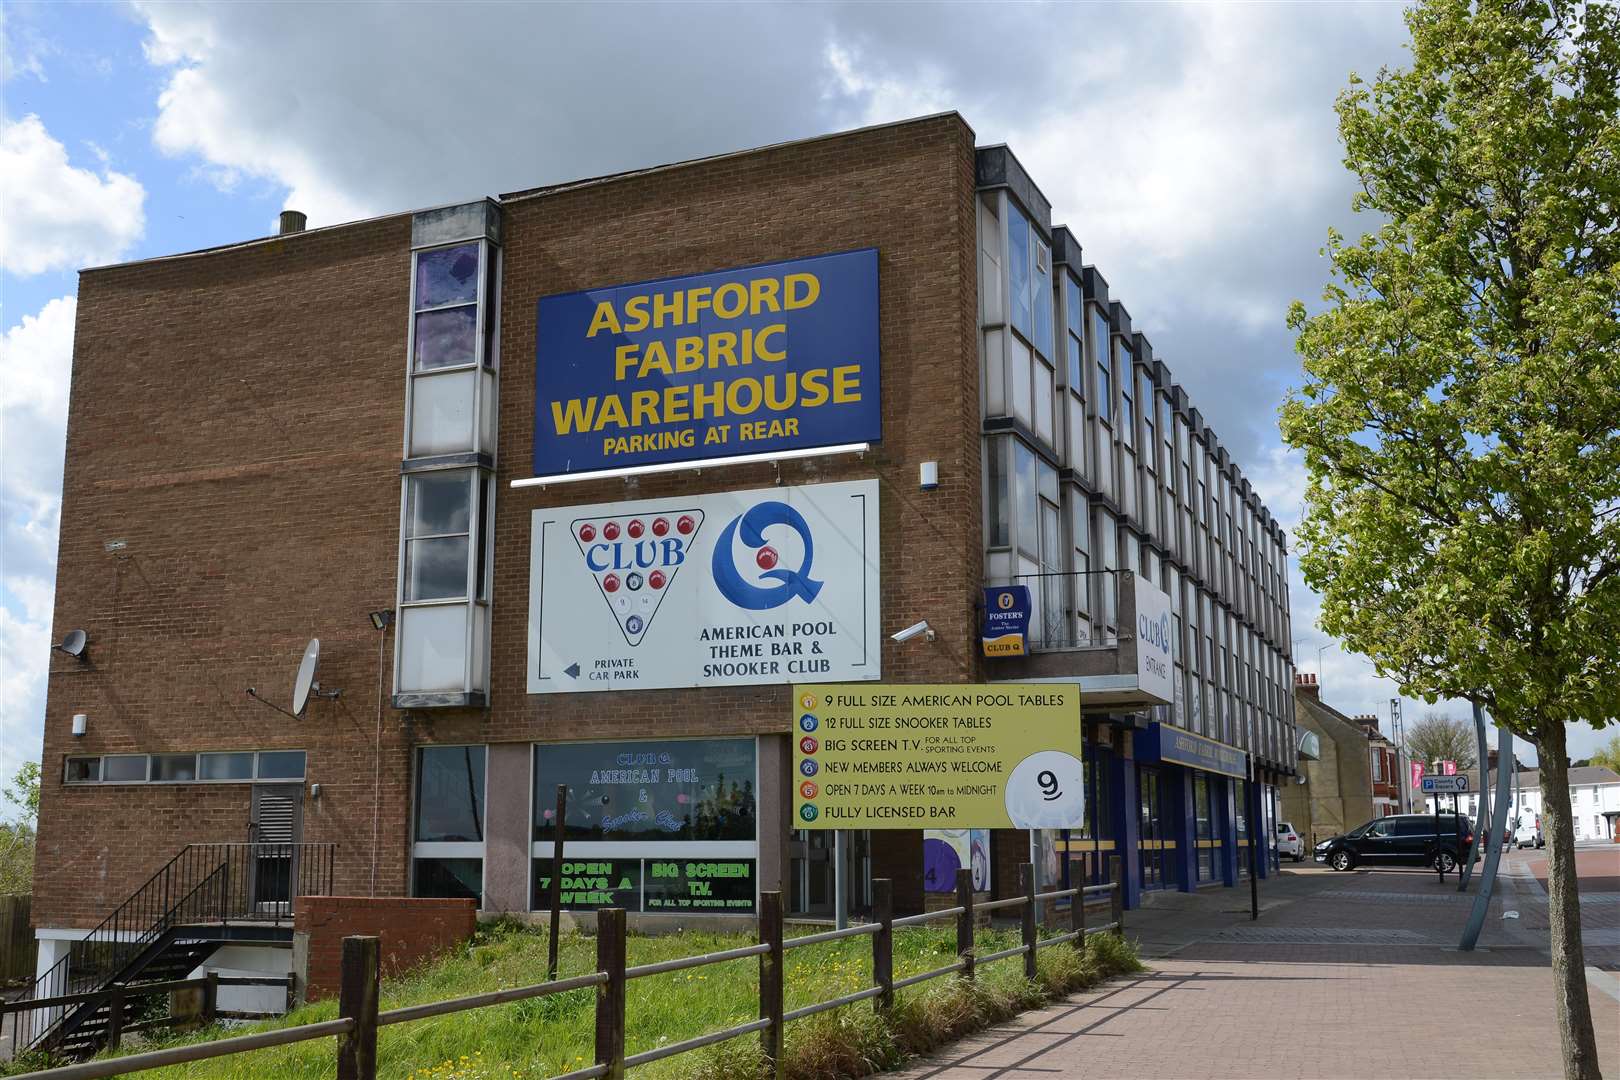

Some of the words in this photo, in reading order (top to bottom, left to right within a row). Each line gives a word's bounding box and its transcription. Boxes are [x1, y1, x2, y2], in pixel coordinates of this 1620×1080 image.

[586, 272, 820, 338] ASHFORD
[615, 324, 787, 381] FABRIC
[551, 364, 862, 436] WAREHOUSE
[603, 429, 695, 456] PARKING
[704, 425, 732, 446] AT
[740, 418, 799, 441] REAR
[586, 538, 685, 572] CLUB
[712, 501, 824, 610] Q
[700, 624, 784, 641] AMERICAN
[792, 622, 836, 636] POOL
[1139, 614, 1160, 648] CLUB
[1160, 609, 1169, 654] Q
[710, 644, 763, 658] THEME
[772, 643, 802, 656] BAR
[811, 642, 824, 654] &
[594, 658, 634, 668] PRIVATE
[704, 662, 780, 678] SNOOKER
[787, 660, 830, 674] CLUB
[589, 671, 610, 681] CAR
[614, 669, 640, 680] PARK
[825, 696, 833, 706] 9
[838, 696, 866, 706] FULL
[872, 696, 897, 706] SIZE
[902, 695, 972, 706] AMERICAN
[976, 695, 1014, 706] POOL
[1020, 695, 1064, 706] TABLES
[825, 718, 836, 728] 12
[840, 718, 864, 728] FULL
[868, 718, 890, 728] SIZE
[894, 717, 948, 728] SNOOKER
[952, 718, 992, 728] TABLES
[825, 740, 846, 751] BIG
[851, 740, 898, 751] SCREEN
[902, 740, 924, 751] T.V.
[825, 762, 850, 773] NEW
[853, 762, 902, 773] MEMBERS
[906, 762, 947, 773] ALWAYS
[950, 762, 1002, 772] WELCOME
[590, 769, 660, 784] AMERICAN
[668, 768, 699, 782] POOL
[1037, 770, 1060, 796] 9
[826, 784, 851, 796] OPEN
[854, 784, 860, 796] 7
[862, 784, 886, 796] DAYS
[888, 784, 897, 796] A
[900, 784, 925, 796] WEEK
[948, 787, 954, 796] to
[956, 785, 996, 796] MIDNIGHT
[1426, 780, 1432, 788] P
[640, 788, 648, 802] &
[825, 806, 862, 818] FULLY
[866, 806, 926, 818] LICENSED
[930, 806, 956, 818] BAR
[561, 863, 612, 875] OPEN
[652, 864, 679, 878] BIG
[685, 863, 750, 878] SCREEN
[926, 868, 937, 884] 4
[540, 878, 552, 889] 7
[560, 877, 608, 890] DAYS
[618, 878, 632, 890] A
[688, 882, 713, 896] T.V.
[560, 892, 614, 904] WEEK
